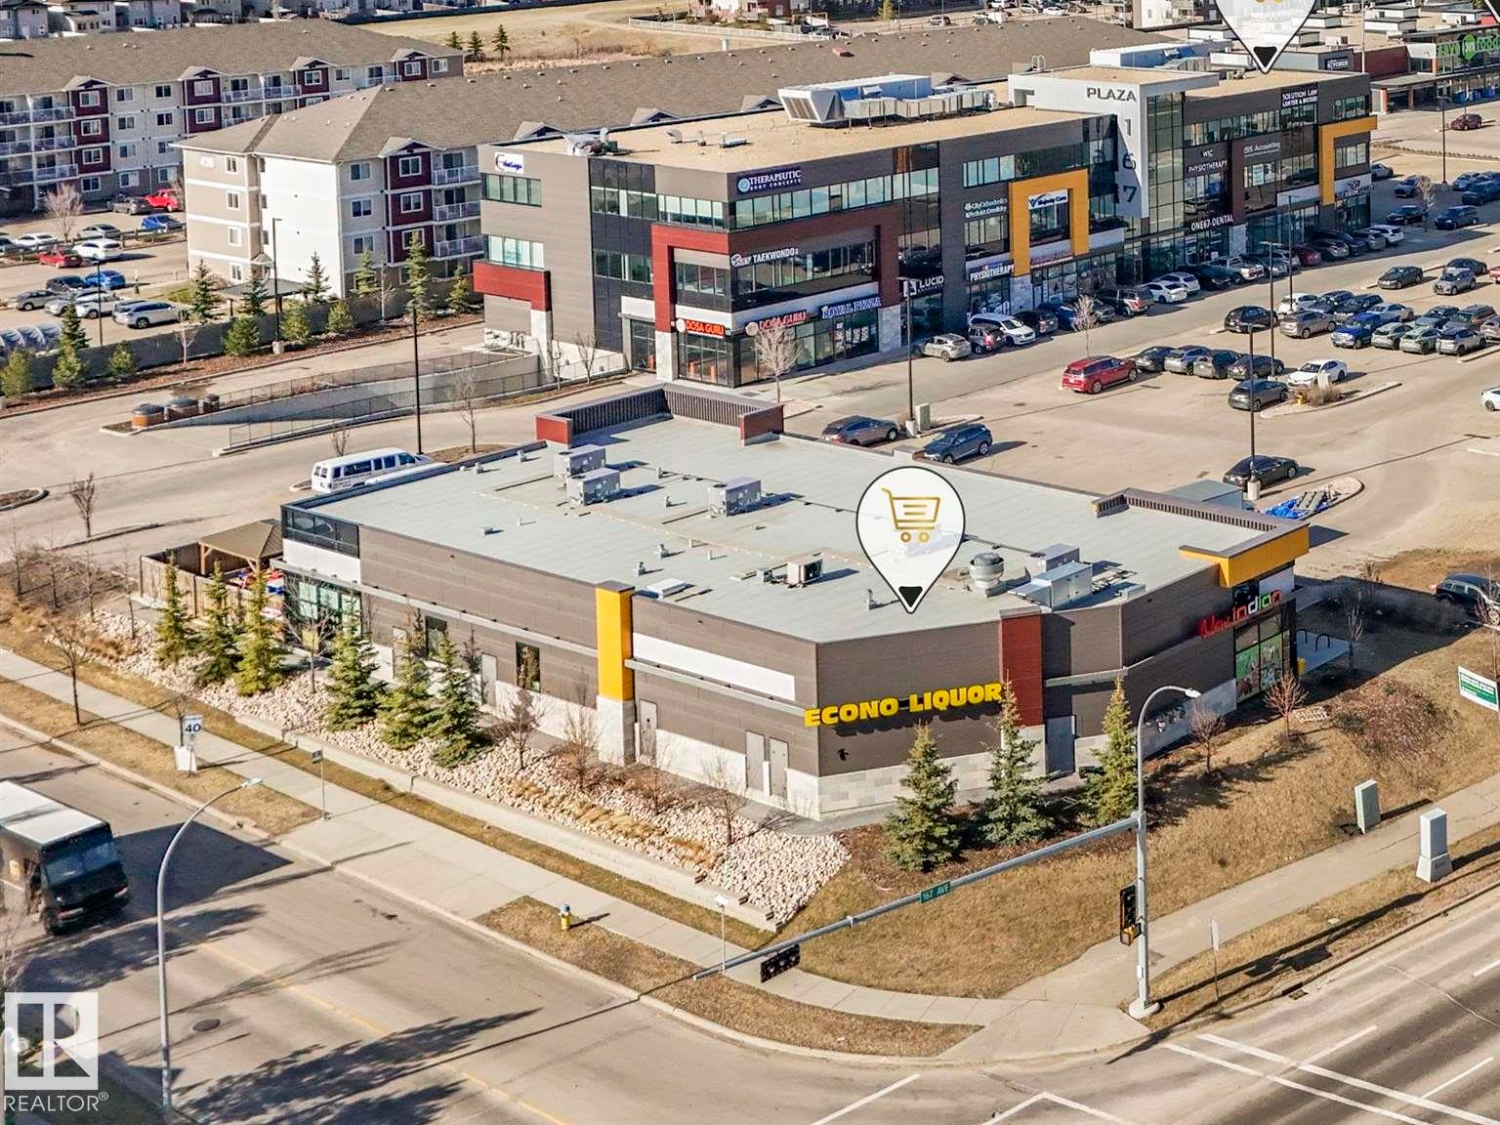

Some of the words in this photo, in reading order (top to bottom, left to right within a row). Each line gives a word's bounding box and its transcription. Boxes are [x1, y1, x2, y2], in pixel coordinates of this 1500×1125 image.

[1087, 87, 1137, 102] PLAZA
[749, 170, 802, 185] THERAPEUTIC
[1212, 214, 1234, 227] DENTAL
[919, 275, 945, 289] LUCID
[687, 321, 704, 332] DOSA
[705, 324, 724, 335] GURU
[804, 697, 899, 727] ECONO
[909, 682, 1001, 713] LIQUOR
[185, 723, 201, 732] 40
[922, 889, 934, 901] 167
[937, 883, 949, 895] AVE
